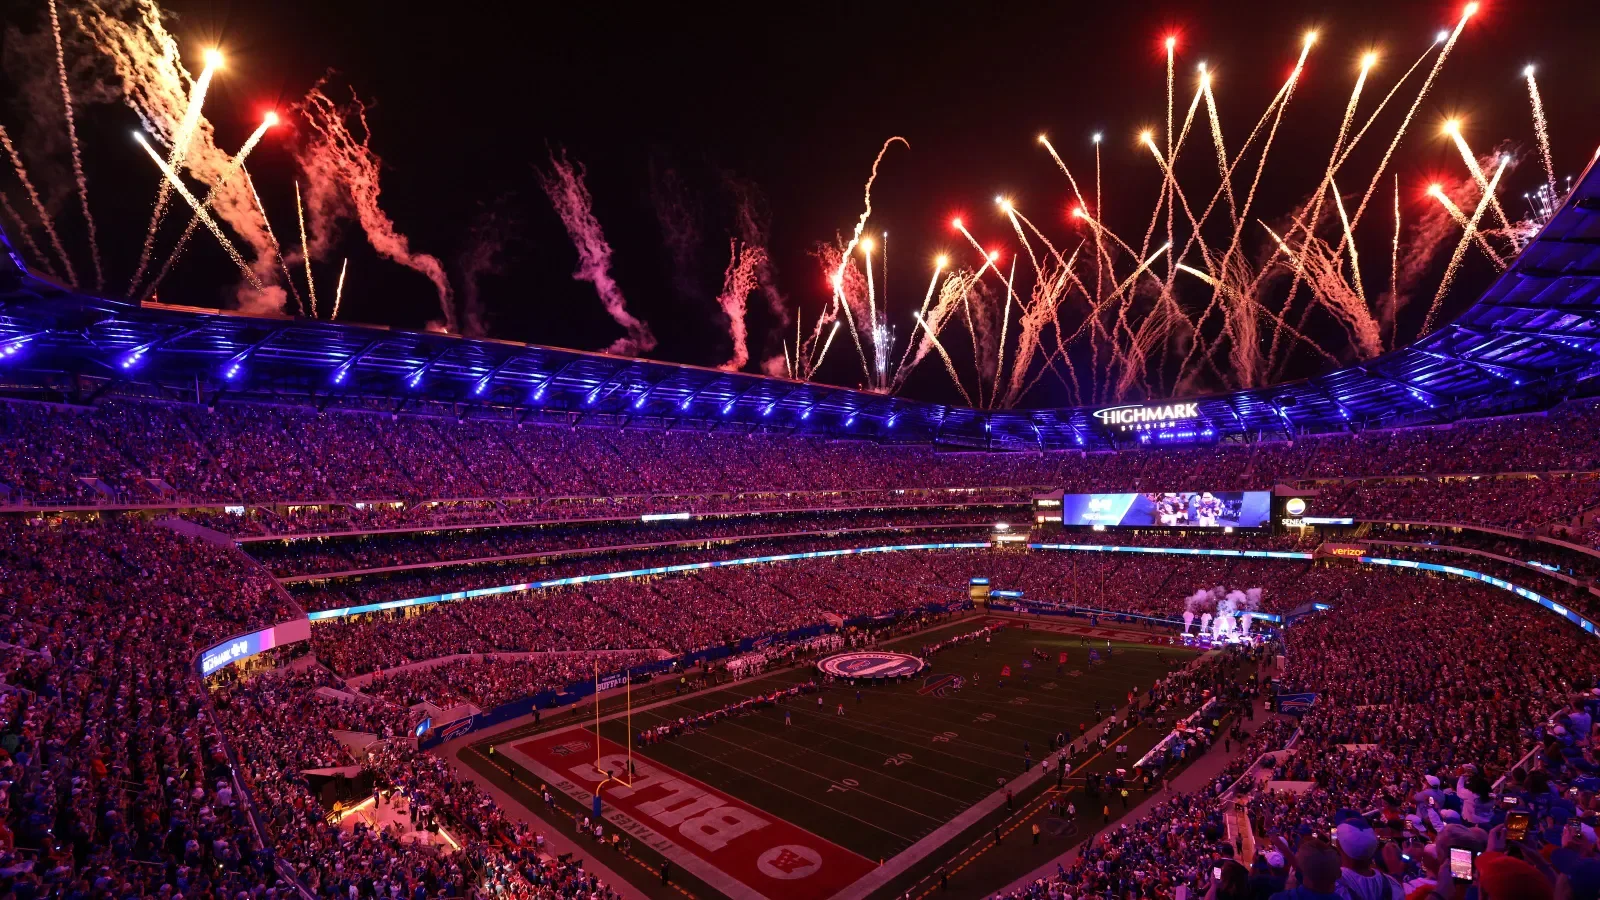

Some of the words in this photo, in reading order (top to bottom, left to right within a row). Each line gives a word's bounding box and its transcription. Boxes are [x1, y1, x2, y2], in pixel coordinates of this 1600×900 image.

[1103, 402, 1198, 424] HIGHMARK
[1121, 421, 1176, 431] STADIUM
[597, 676, 627, 692] BUFFALO
[886, 753, 914, 766] 20
[556, 781, 575, 791] US
[831, 778, 860, 792] 10
[573, 789, 591, 800] OF
[567, 754, 773, 853] BILLS
[611, 813, 656, 841] TAKES
[652, 840, 674, 852] IT
